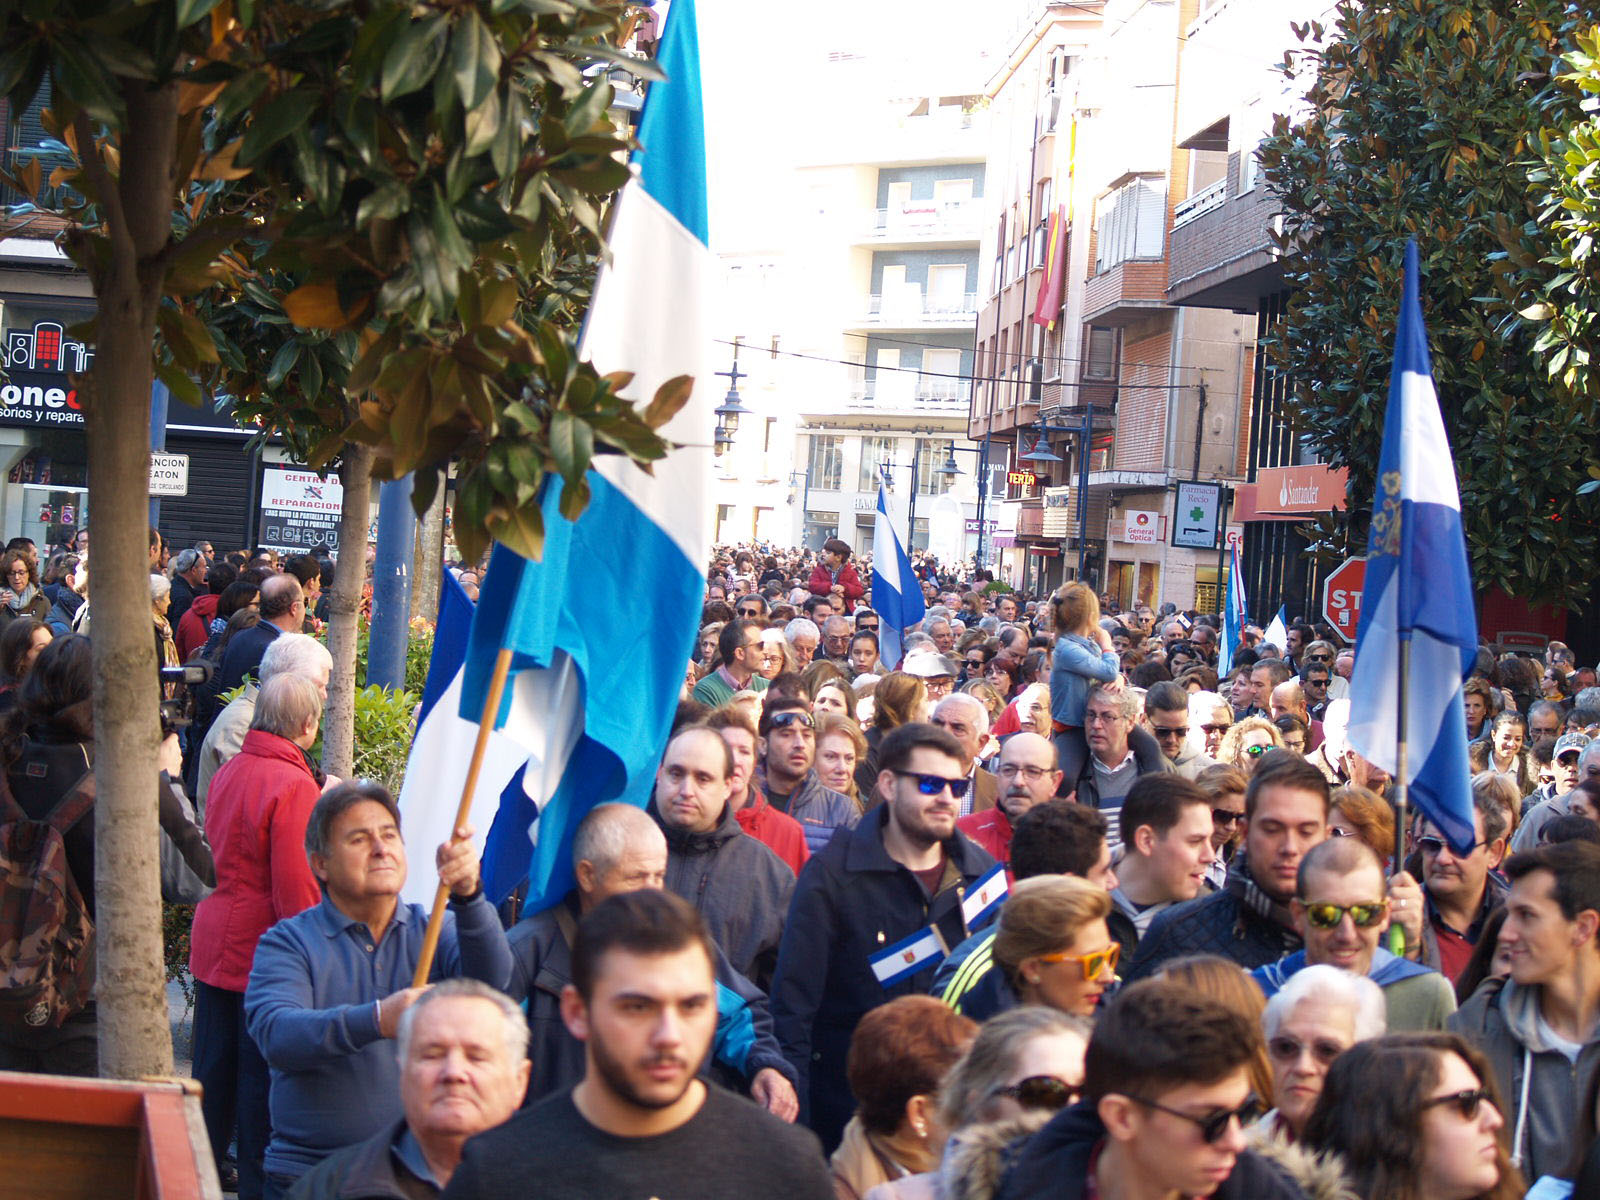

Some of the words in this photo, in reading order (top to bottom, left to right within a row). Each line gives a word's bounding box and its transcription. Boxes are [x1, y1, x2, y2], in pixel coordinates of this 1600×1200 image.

[0, 407, 33, 419] sorios
[35, 411, 43, 422] y
[46, 411, 85, 423] repara
[1181, 484, 1216, 495] Farmacia
[1288, 476, 1319, 505] Santander
[271, 498, 341, 511] REPARACION
[1187, 494, 1209, 503] Recio
[1127, 527, 1155, 536] General
[1330, 589, 1363, 610] ST
